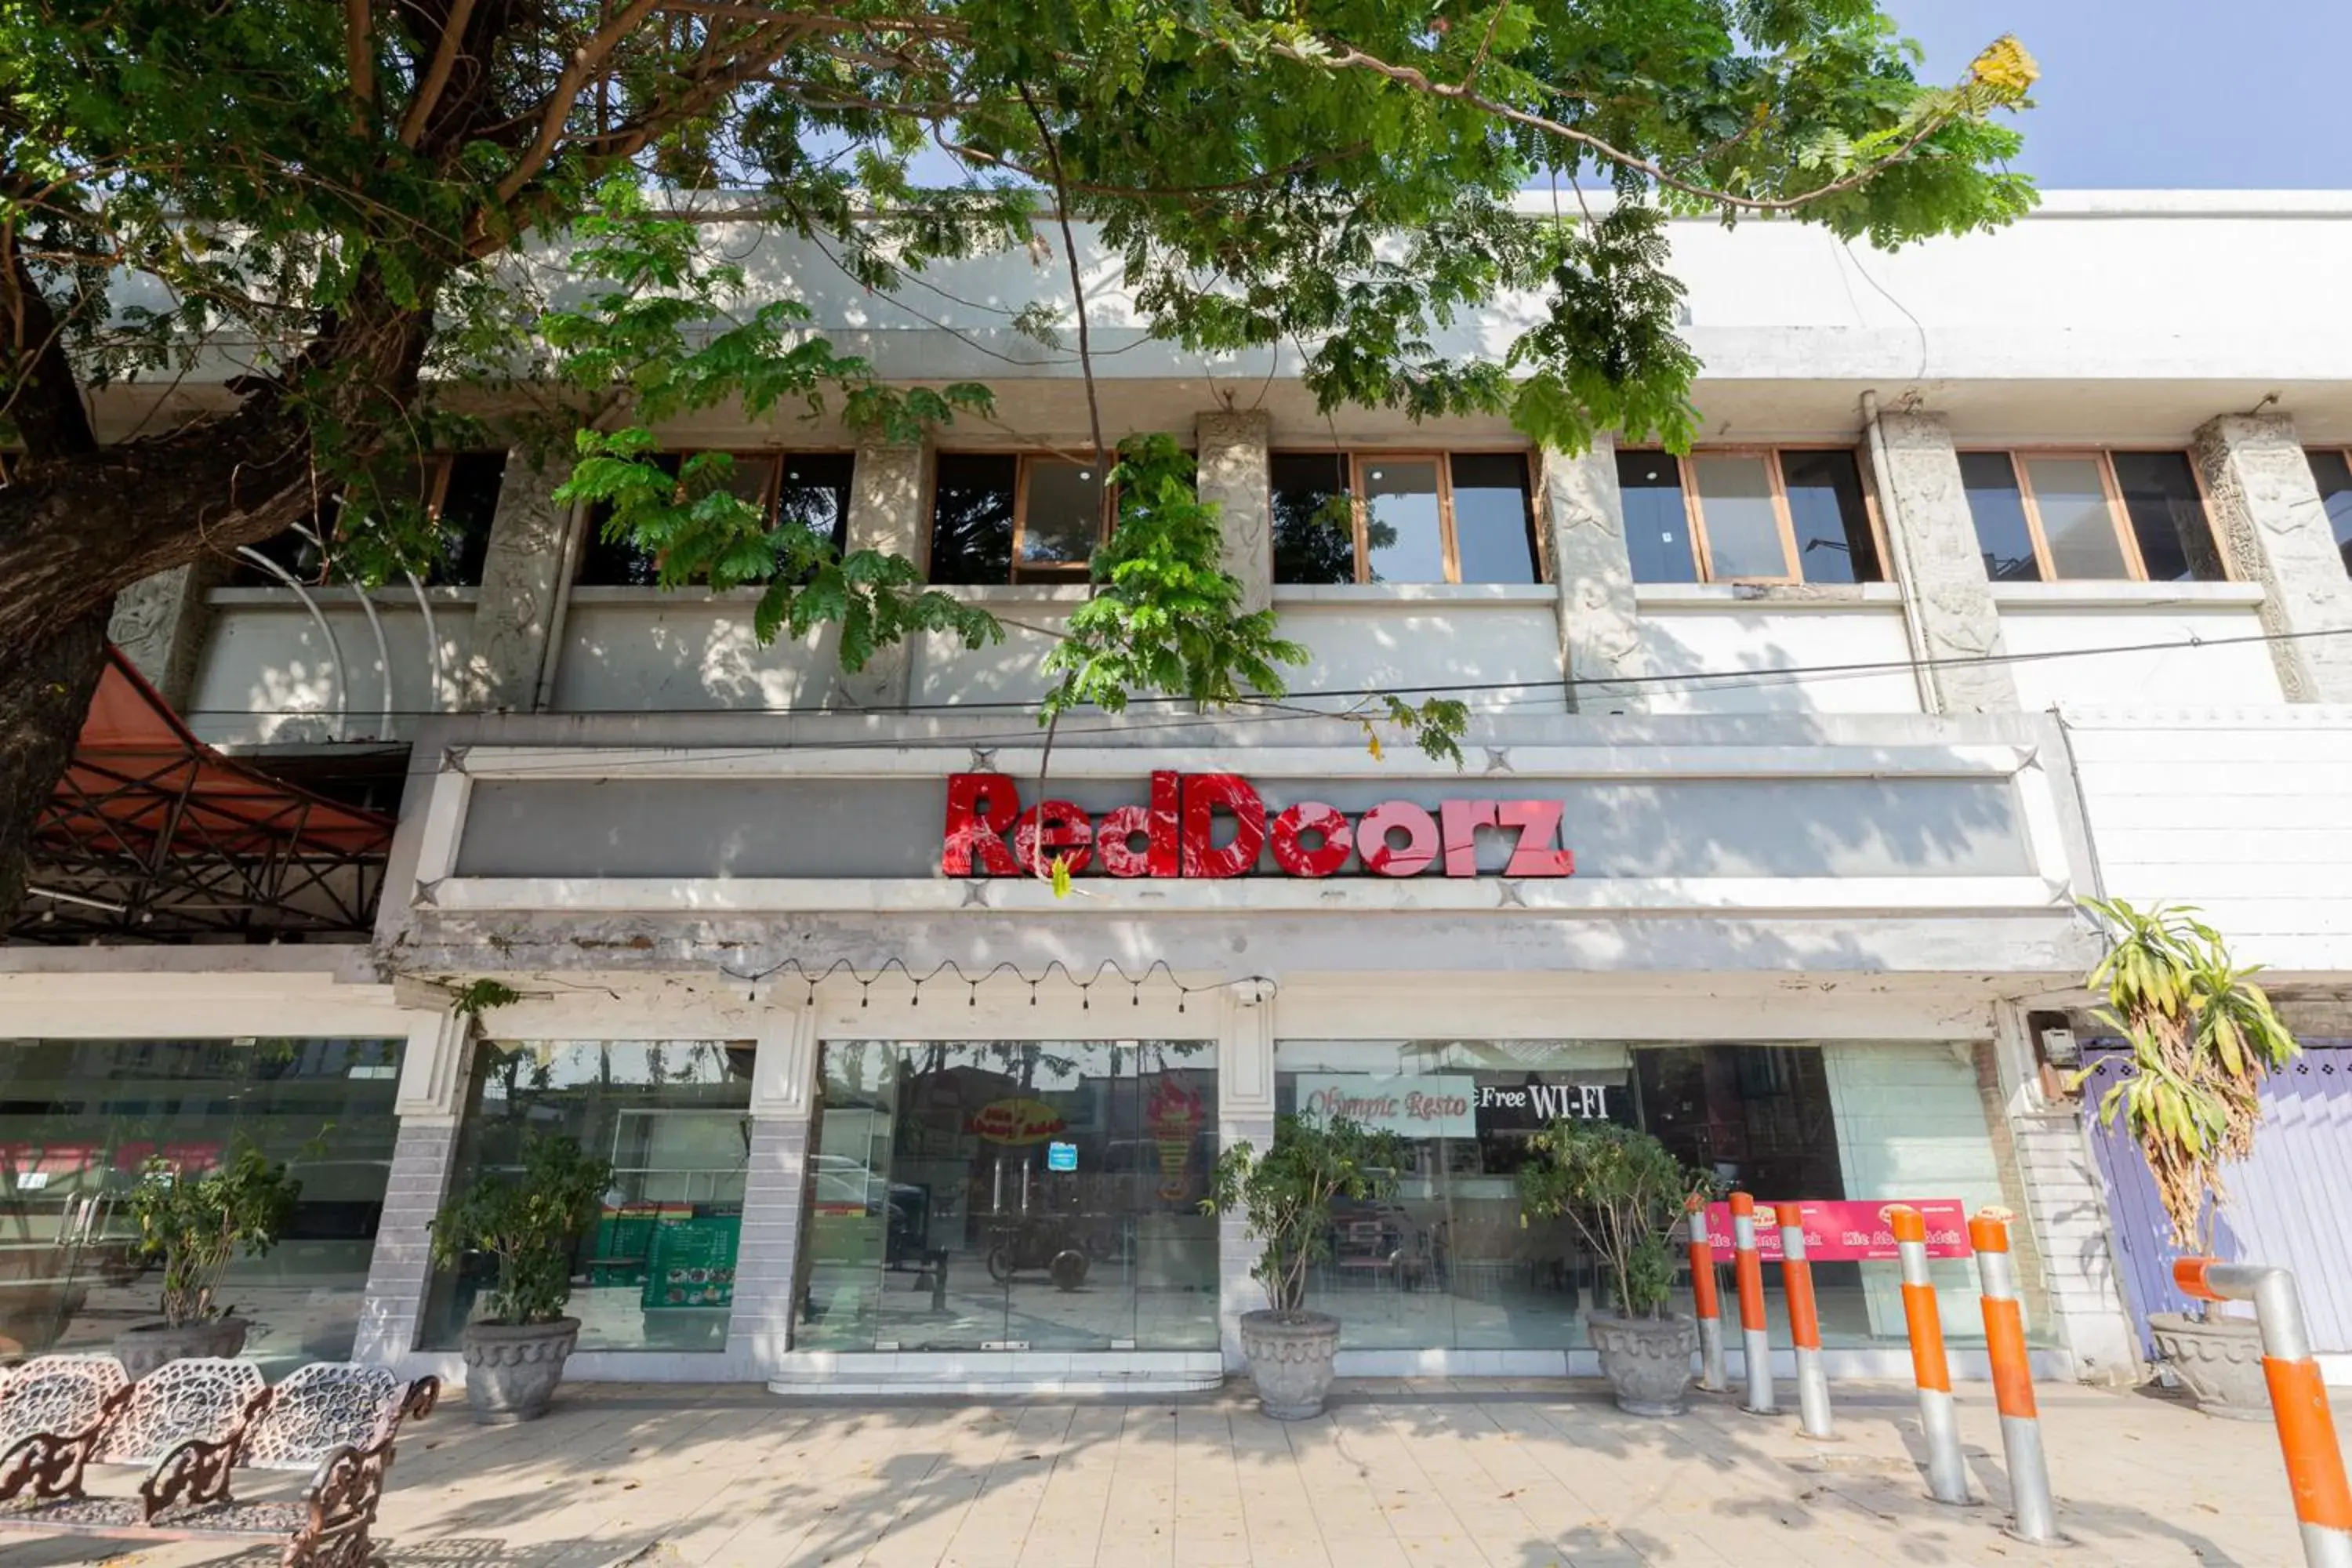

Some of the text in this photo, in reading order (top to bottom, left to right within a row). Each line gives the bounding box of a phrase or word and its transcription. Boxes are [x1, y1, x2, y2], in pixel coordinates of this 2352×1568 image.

[942, 770, 1575, 877] RedDoorz
[1405, 1091, 1468, 1120] Resto
[1481, 1087, 1526, 1108] Free
[1527, 1085, 1610, 1120] WI-FI
